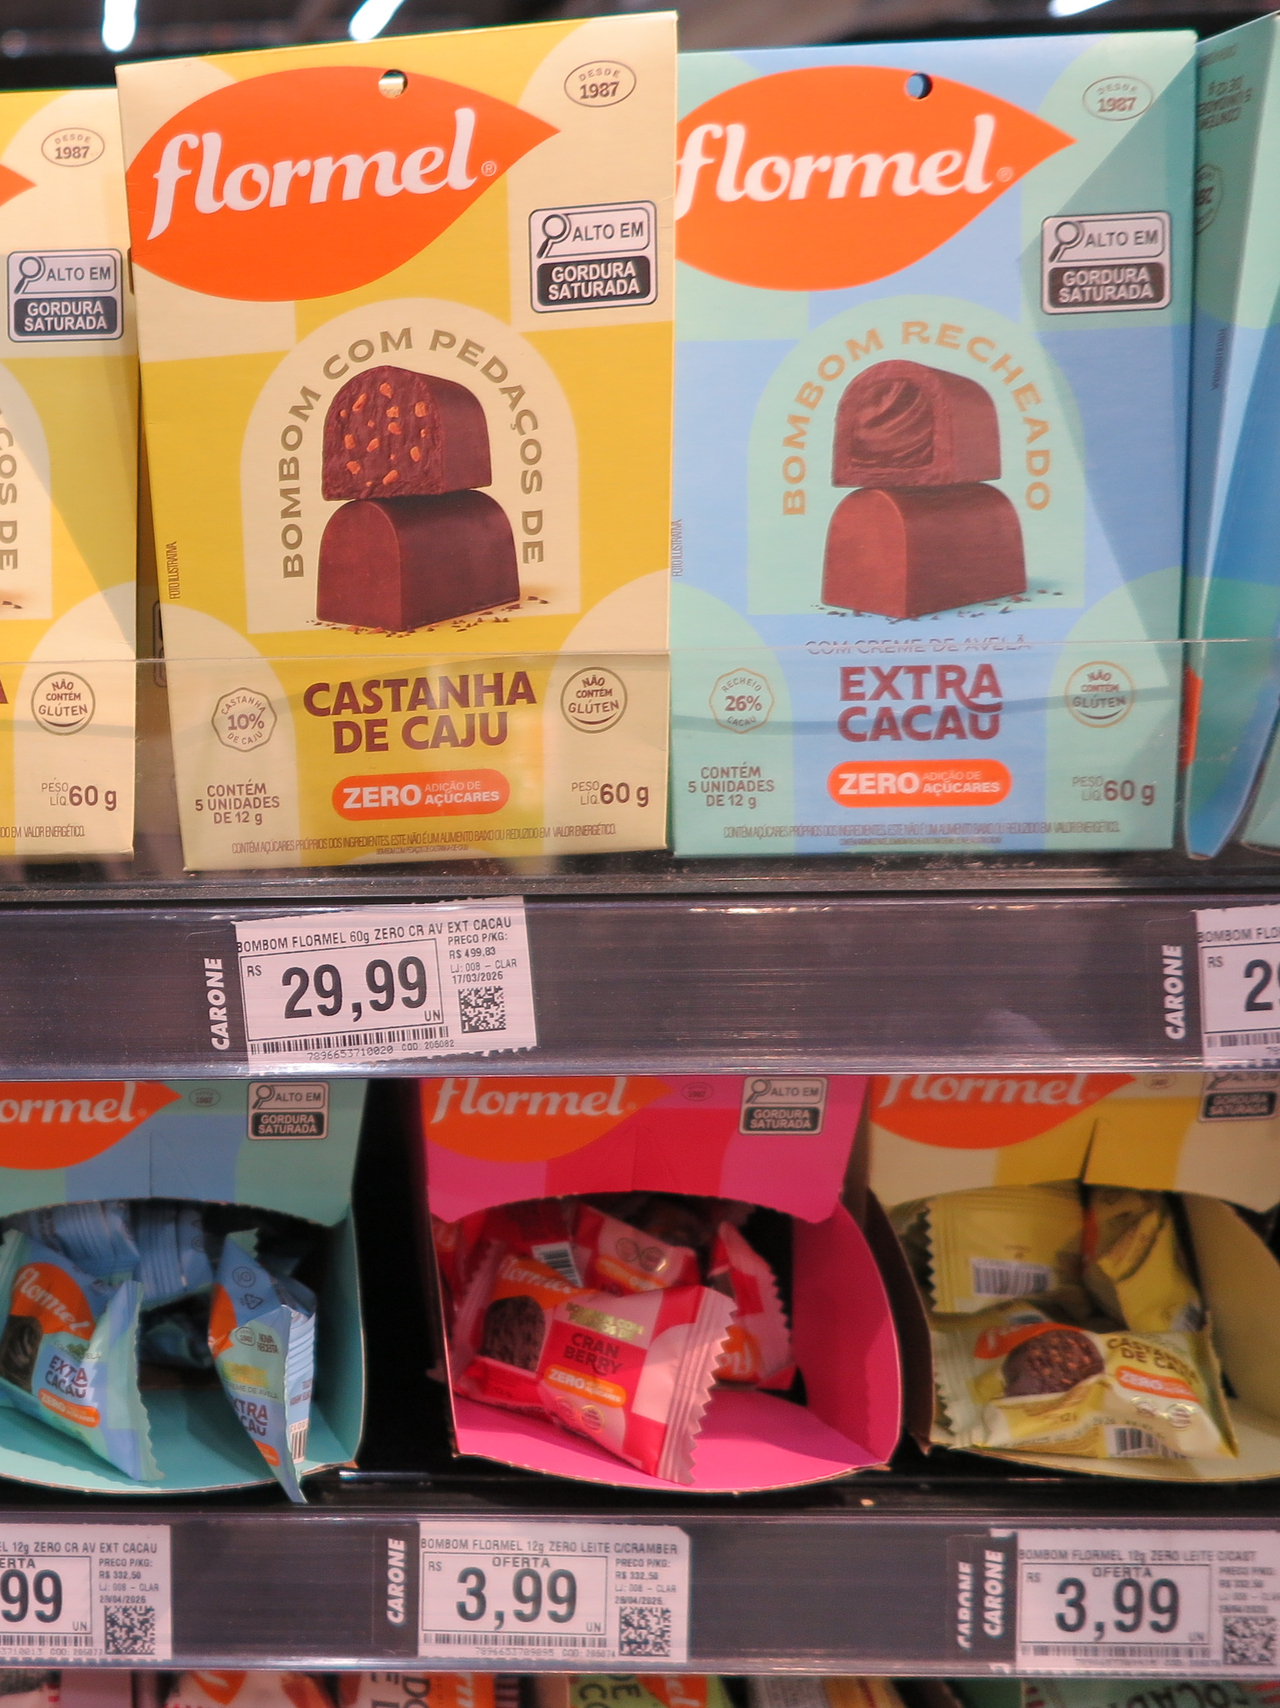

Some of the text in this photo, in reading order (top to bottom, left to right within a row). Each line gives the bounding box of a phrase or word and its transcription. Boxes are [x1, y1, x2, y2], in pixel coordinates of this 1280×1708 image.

[577, 67, 621, 83] DESDE
[579, 81, 619, 100] 1987
[1097, 95, 1138, 114] 1987
[147, 107, 478, 240] flormel
[675, 114, 994, 221] flormel
[572, 221, 645, 243] ALTO EM
[46, 266, 111, 282] ALTO EM
[551, 262, 637, 284] GORDURA
[1062, 267, 1151, 286] GORDURA
[548, 279, 641, 301] SATURADA
[1058, 283, 1154, 303] SATURADA
[27, 300, 104, 316] GORDURA
[23, 316, 108, 333] SATURADA
[782, 320, 1052, 517] BOMBOM RECHEADO
[278, 327, 544, 579] BOMBOM COM PEDAÇOS DE
[51, 678, 75, 692] NÃO
[302, 670, 537, 717] CASTANHA
[839, 663, 1003, 715] EXTRA
[46, 691, 82, 702] CONTÉM
[724, 694, 763, 713] 26%
[38, 702, 88, 718] GLÚTEN
[226, 712, 266, 732] 10%
[333, 711, 509, 755] DE CAJU
[837, 705, 1001, 743] CACAU
[700, 763, 762, 780] CONTÉM
[424, 780, 481, 794] ADIÇÃO DE
[688, 778, 775, 794] 5 UNIDADES
[838, 772, 920, 795] ZERO
[1103, 778, 1156, 806] 60 g
[69, 785, 117, 811] 60 g
[342, 783, 422, 810] ZERO
[424, 789, 500, 806] AÇÚCARES
[599, 782, 650, 808] 60 g
[237, 917, 512, 953] BOMBOM FLORMEL 60g ZERO CR AV EXT CACAU
[281, 956, 428, 1023] 29,99
[1162, 945, 1186, 1040] CARONE
[203, 957, 230, 1050] CARONE
[430, 1077, 626, 1125] flormel
[260, 1114, 316, 1125] GORDURA
[749, 1118, 812, 1130] SATURADA
[753, 1109, 810, 1120] GORDURA
[258, 1123, 318, 1135] SATURADA
[572, 1333, 620, 1359] CRAN
[563, 1346, 623, 1377] BERRY
[45, 1371, 87, 1398] CACAU
[12, 1542, 29, 1554] 12g
[34, 1542, 61, 1553] ZERO
[82, 1543, 96, 1553] AV
[100, 1543, 119, 1553] EXT
[122, 1543, 157, 1554] CACAU
[420, 1538, 469, 1549] BOMBOM
[473, 1539, 522, 1550] FLORMEL
[527, 1541, 544, 1555] 12g
[549, 1541, 577, 1552] ZERO
[581, 1542, 610, 1553] LEITE
[492, 1556, 551, 1568] OFERTA
[1092, 1567, 1152, 1578] OFERTA
[387, 1538, 406, 1625] CARONE
[456, 1567, 577, 1631] 3,99
[983, 1550, 1005, 1639] CARONE
[1055, 1578, 1180, 1642] 3,99
